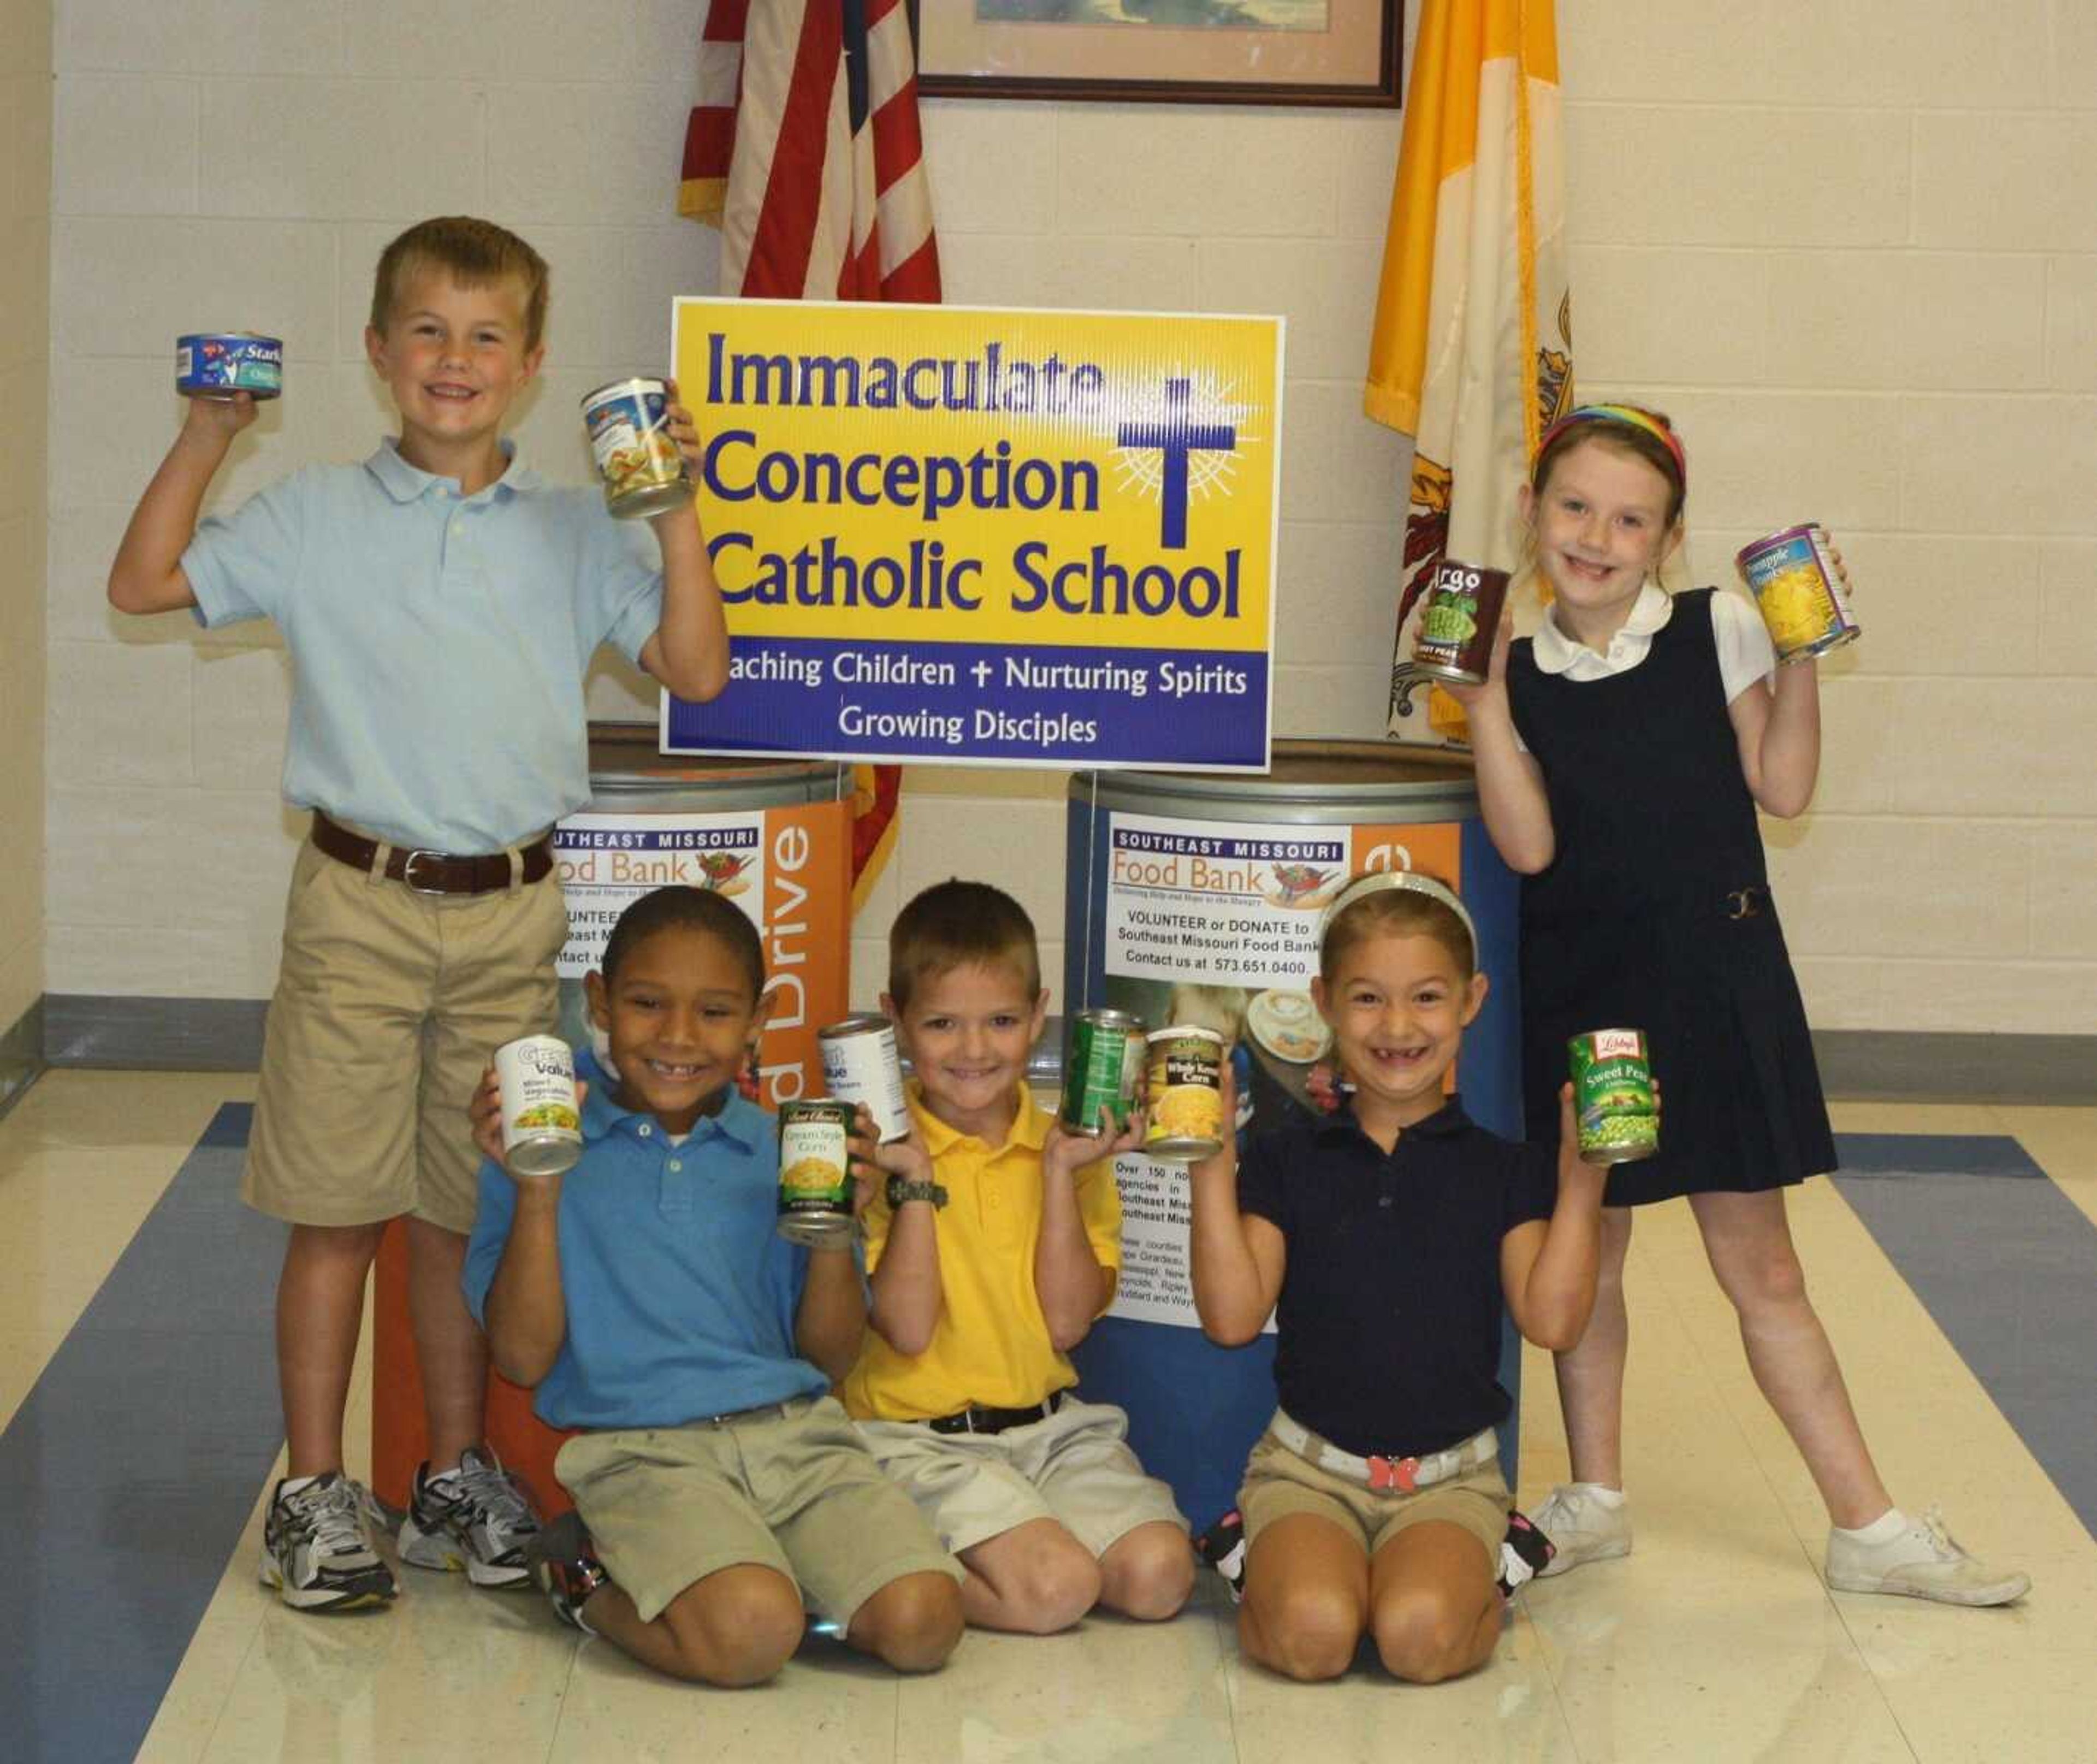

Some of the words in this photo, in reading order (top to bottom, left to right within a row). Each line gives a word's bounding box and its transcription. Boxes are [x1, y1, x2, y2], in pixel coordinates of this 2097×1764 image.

[706, 333, 1106, 413] Immaculate
[704, 430, 1099, 521] Conception
[707, 532, 983, 610] Catholic
[1011, 542, 1241, 618] School
[730, 653, 822, 687] aching
[833, 653, 955, 686] Children
[1005, 658, 1148, 696] Nurturing
[1159, 662, 1247, 698] Spirits
[838, 704, 963, 744] Growing
[974, 710, 1097, 747] Disciples
[554, 832, 646, 848] UTHEAST
[658, 830, 755, 848] MISSOURI
[1118, 832, 1223, 854] SOUTHEAST
[1234, 842, 1337, 859] MISSOURI
[558, 851, 596, 883] od
[611, 852, 689, 883] Bank
[1113, 850, 1178, 886] Food
[1190, 858, 1264, 892] Bank
[763, 825, 809, 1031] Drive
[1128, 909, 1207, 929] VOLUNTEER
[1210, 919, 1225, 930] or
[1229, 920, 1290, 935] DONATE
[1295, 923, 1310, 935] to
[1118, 926, 1178, 946] Southeast
[1182, 934, 1239, 950] Missouri
[1243, 938, 1279, 952] Food
[1284, 941, 1320, 953] Bank
[1125, 950, 1172, 966] Contact
[1176, 957, 1190, 967] us
[1195, 957, 1207, 970] at
[1586, 1067, 1622, 1085] Sweet
[1115, 1162, 1139, 1174] Over
[1148, 1167, 1166, 1178] 150
[1118, 1191, 1165, 1208] outheast
[1170, 1184, 1180, 1194] in
[1122, 1209, 1165, 1223] outheast
